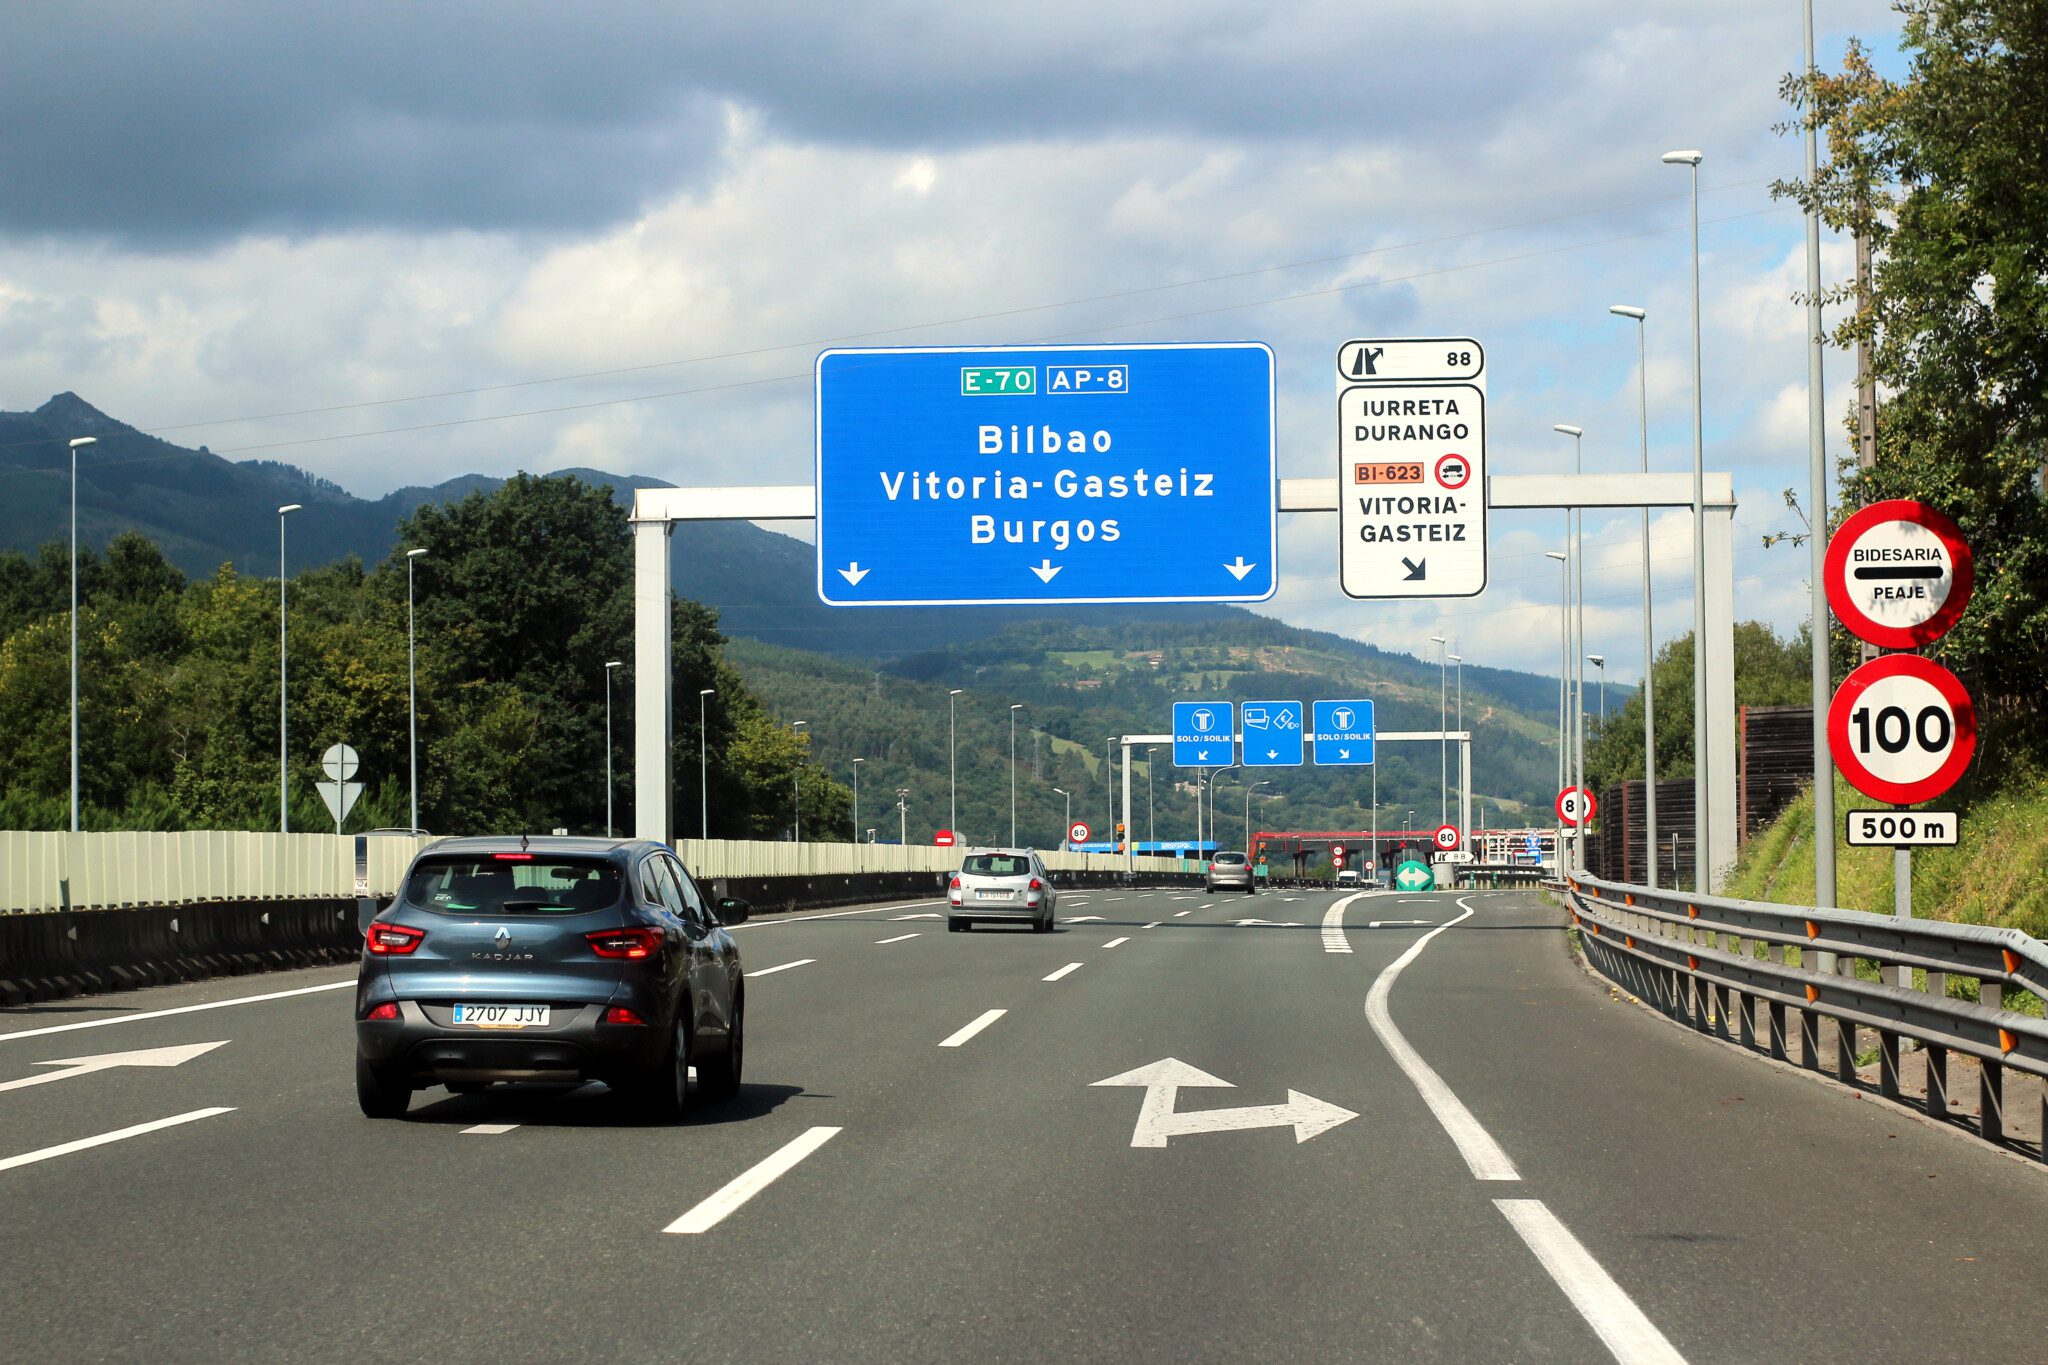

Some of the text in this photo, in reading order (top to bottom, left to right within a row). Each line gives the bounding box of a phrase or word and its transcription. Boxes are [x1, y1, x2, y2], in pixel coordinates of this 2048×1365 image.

[1446, 351, 1472, 367] 88
[965, 371, 1032, 391] E-70
[1051, 369, 1124, 390] AP-8
[1362, 399, 1460, 417] IURRETA
[978, 424, 1113, 455] Bilbao
[1355, 423, 1470, 442] DURANGO
[1357, 464, 1422, 481] BI-623
[879, 467, 1215, 501] Vitoria-Gasteiz
[1358, 496, 1467, 515] VITORIA-
[971, 513, 1122, 552] Burgos
[1360, 523, 1467, 543] GASTEIZ
[1853, 547, 1943, 563] BIDESARIA
[1873, 585, 1926, 600] PEAJE
[1851, 704, 1952, 754] 100
[1073, 829, 1086, 837] 80
[1861, 816, 1945, 839] 500 m
[1440, 833, 1454, 842] 80
[471, 952, 534, 961] KADJAR
[464, 1006, 546, 1023] 2707 JJY
